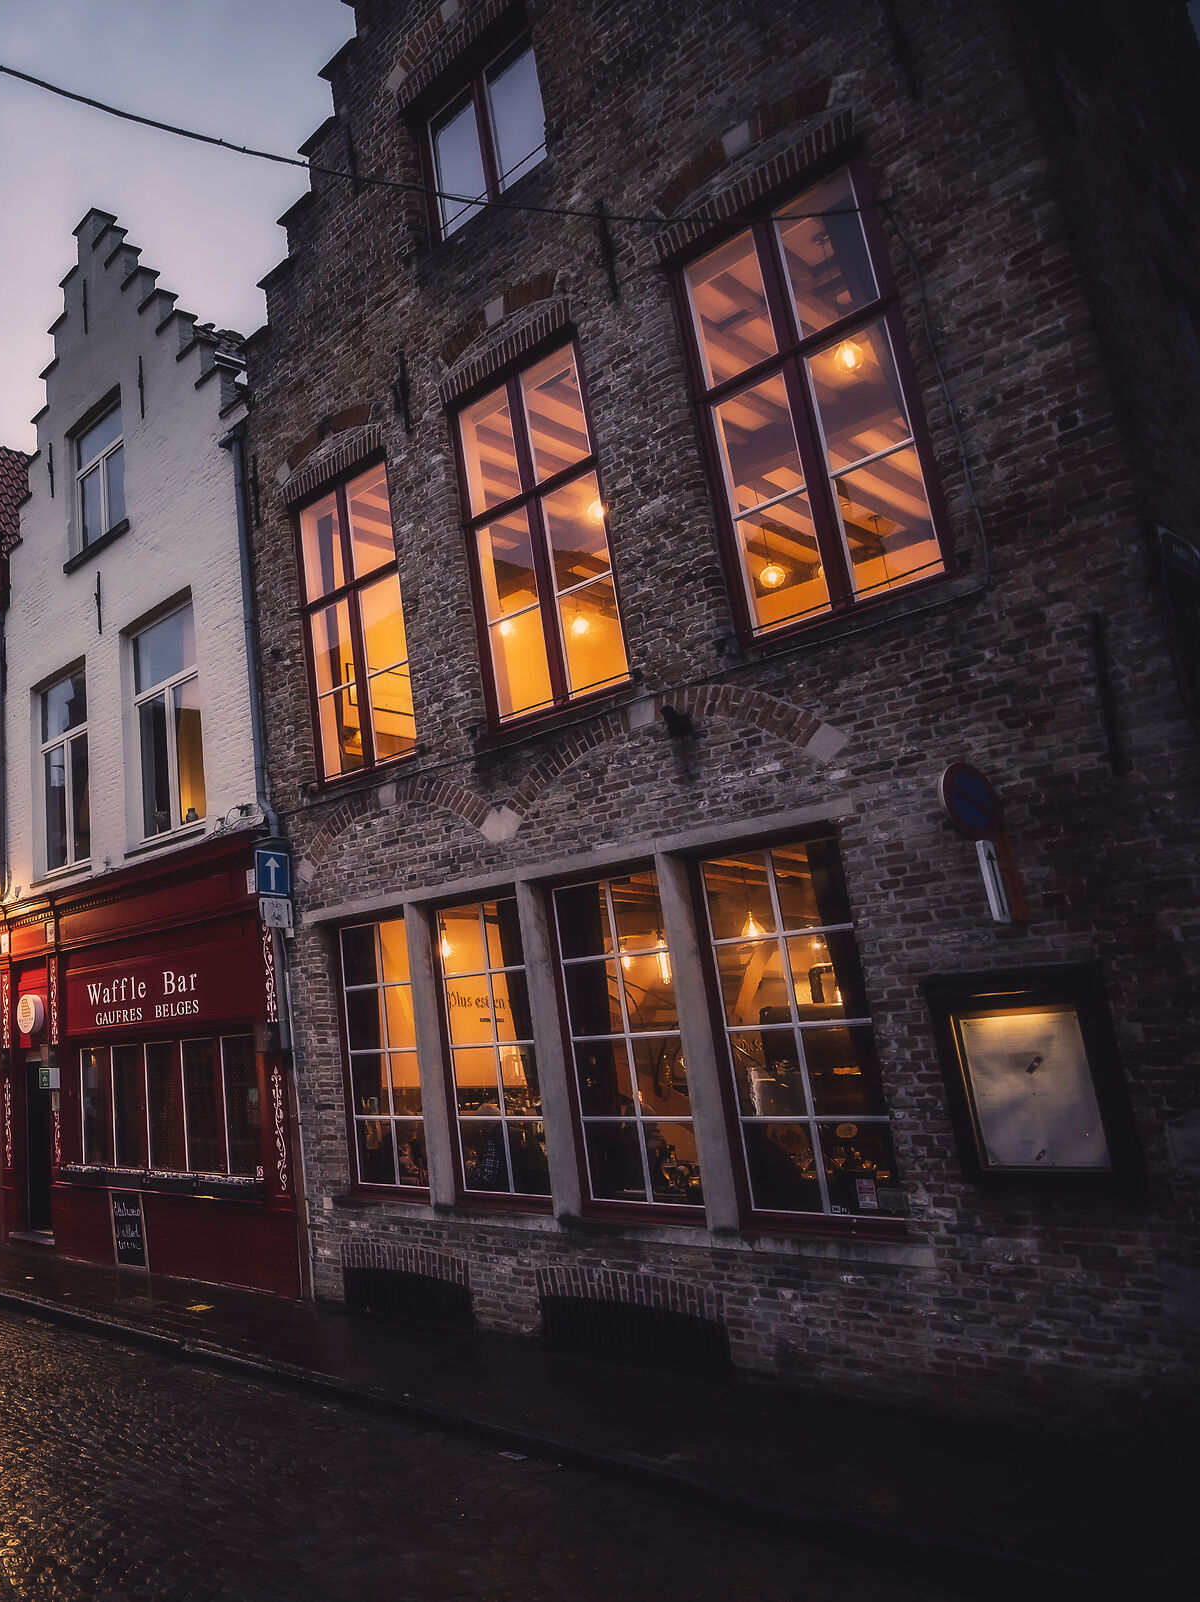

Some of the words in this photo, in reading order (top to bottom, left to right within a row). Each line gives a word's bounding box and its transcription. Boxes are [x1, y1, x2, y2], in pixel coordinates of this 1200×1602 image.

[87, 976, 147, 1006] Waffle
[162, 970, 197, 995] Bar
[95, 1007, 143, 1026] GAUFRES
[155, 999, 200, 1019] BELGES
